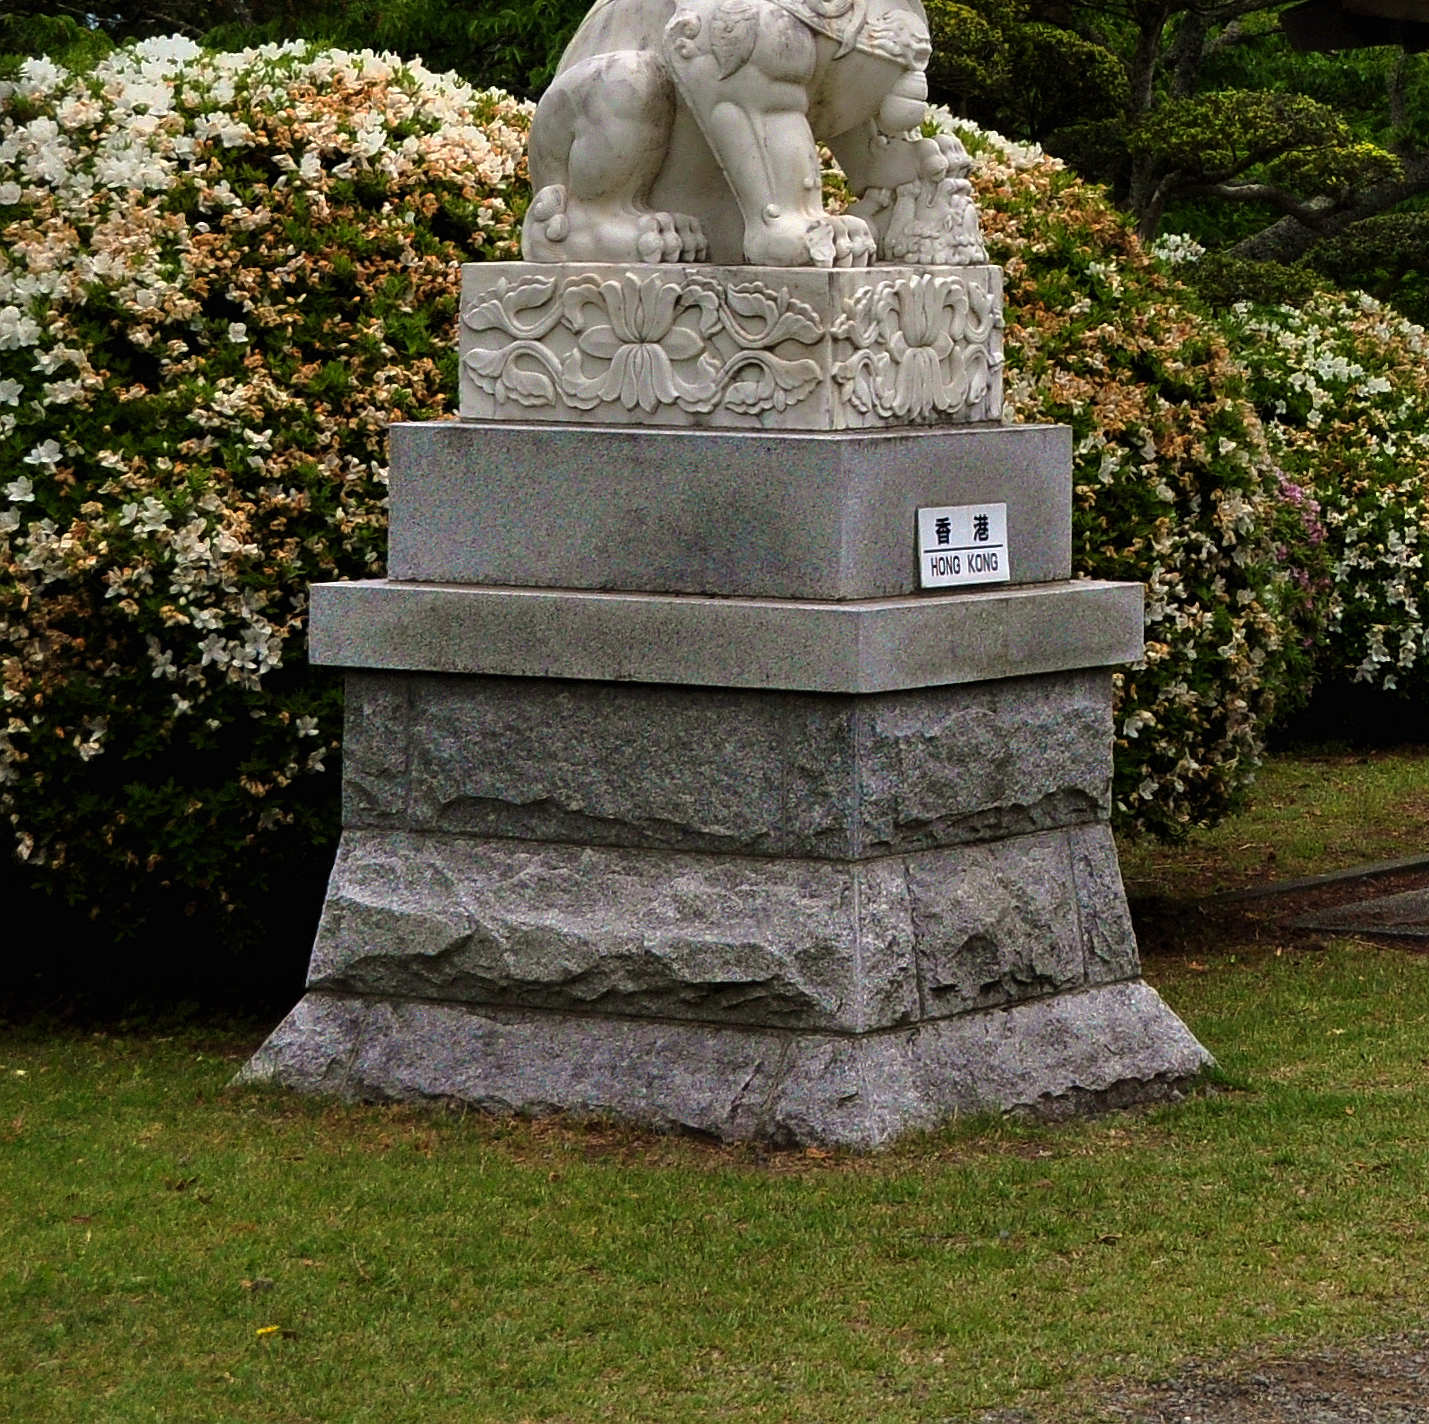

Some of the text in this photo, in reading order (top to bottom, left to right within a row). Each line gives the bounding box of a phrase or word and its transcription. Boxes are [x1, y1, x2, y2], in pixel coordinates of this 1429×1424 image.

[935, 514, 989, 544] 香港
[931, 552, 998, 576] HONG KONG
